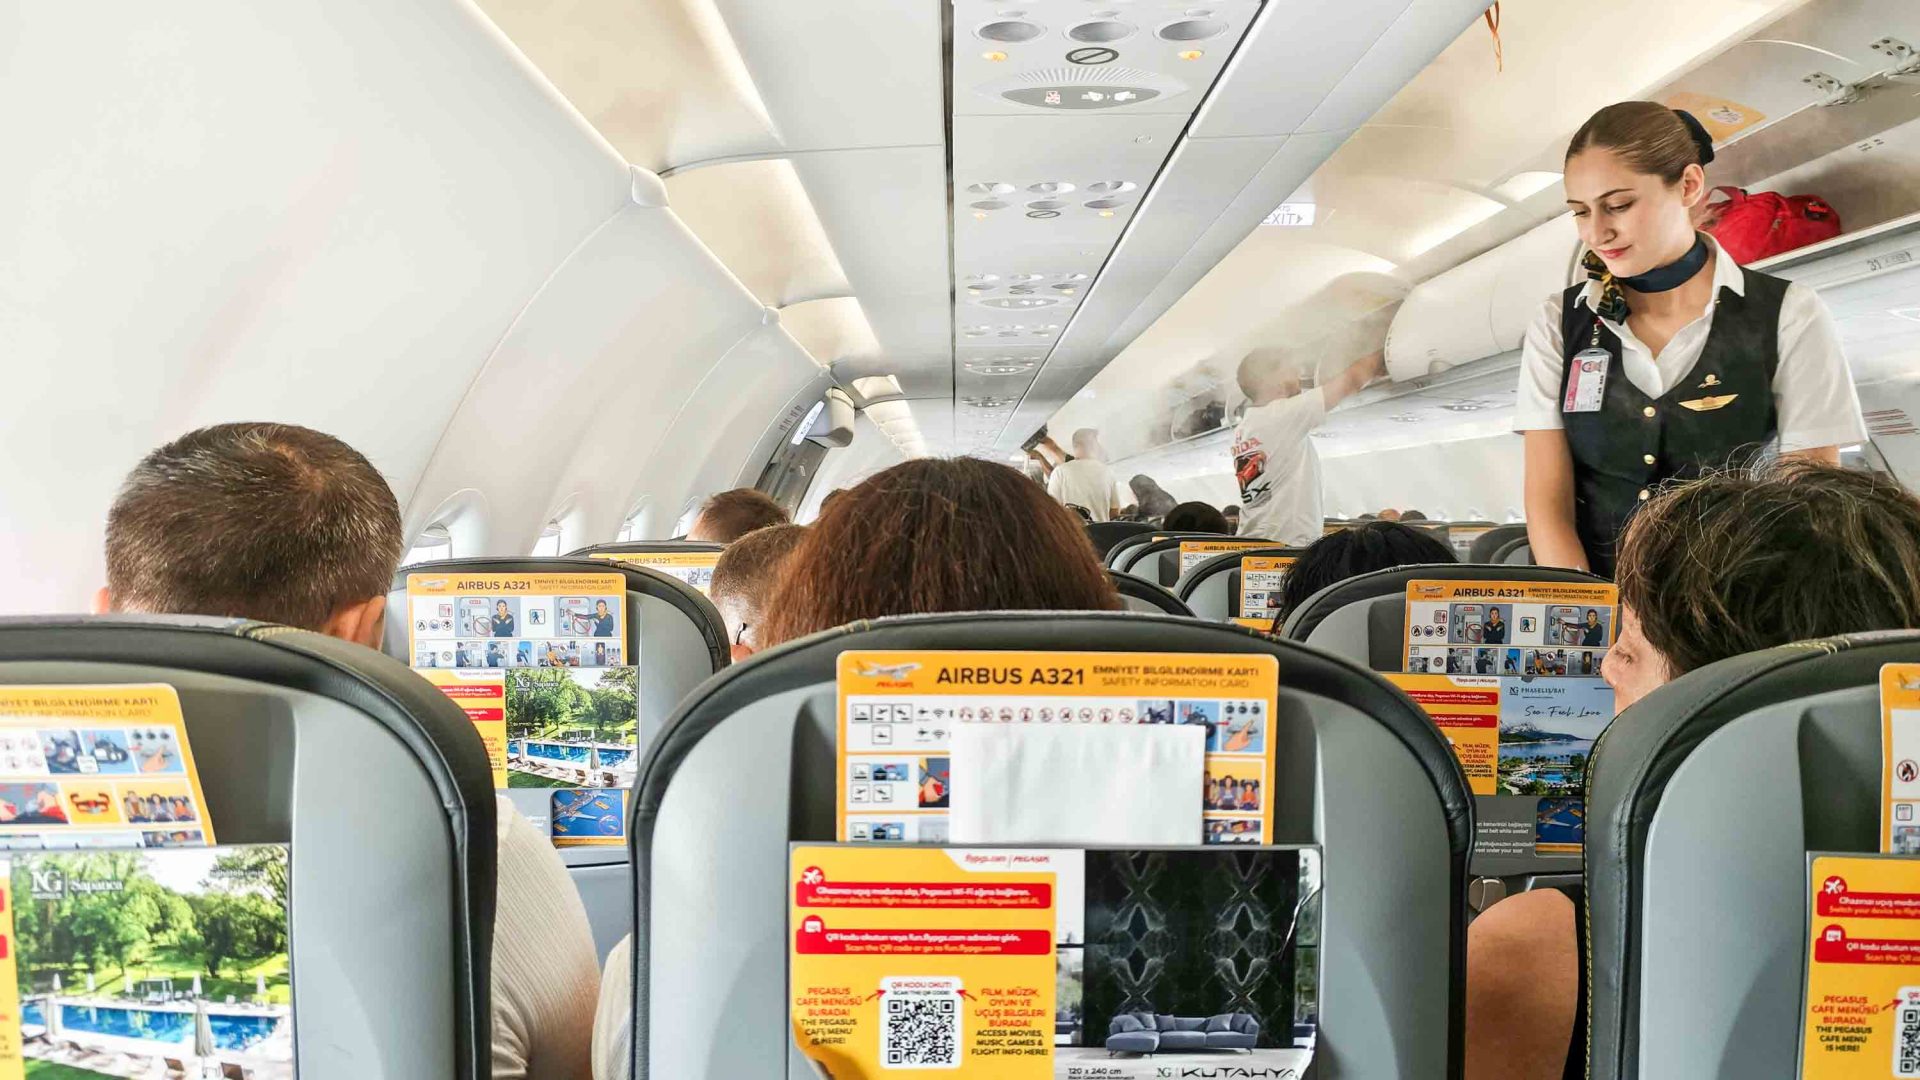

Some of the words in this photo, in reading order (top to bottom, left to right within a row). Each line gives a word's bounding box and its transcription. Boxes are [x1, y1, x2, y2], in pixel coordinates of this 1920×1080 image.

[1262, 213, 1297, 225] XIT
[652, 557, 671, 565] A321
[457, 580, 500, 591] AIRBUS
[503, 580, 531, 590] A321
[1453, 588, 1495, 598] AIRBUS
[1498, 588, 1525, 598] A321
[1092, 665, 1140, 675] EMNİYET
[1142, 666, 1225, 677] BİLGİLENDİRME
[1226, 668, 1259, 677] KARTI
[936, 667, 1023, 685] AIRBUS
[1029, 668, 1084, 685] A321
[516, 677, 530, 687] NG
[1101, 676, 1141, 687] SAFETY
[1143, 677, 1217, 688] INFORMATION
[1219, 679, 1249, 688] CARD
[1509, 686, 1519, 694] NG
[1577, 706, 1601, 718] Love
[32, 870, 62, 892] NG
[70, 879, 123, 893] Sapanca
[879, 944, 893, 953] QR
[1846, 942, 1860, 952] QR
[1865, 953, 1885, 961] Scan
[1885, 954, 1899, 962] the
[1899, 954, 1912, 963] QR
[807, 987, 851, 995] PEGASUS
[1907, 991, 1919, 999] QR
[796, 997, 819, 1006] CAFE
[821, 995, 863, 1006] MENÜSÜ
[989, 999, 1017, 1007] OYUN
[1020, 999, 1032, 1007] VE
[1823, 995, 1868, 1004] PEGASUS
[807, 1008, 851, 1017] BURADA!
[974, 1008, 1002, 1019] UÇUŞ
[1811, 1005, 1835, 1014] CAFE
[1837, 1004, 1879, 1015] MENÜSÜ
[800, 1018, 817, 1026] THE
[818, 1018, 858, 1026] PEGASUS
[989, 1019, 1032, 1028] BURADA!
[1823, 1015, 1867, 1025] BURADA!
[827, 1027, 853, 1036] MENU
[976, 1029, 1008, 1037] ACCESS
[1009, 1029, 1044, 1038] MOVIES,
[1816, 1025, 1832, 1033] THE
[1834, 1026, 1873, 1034] PEGASUS
[976, 1039, 1006, 1047] MUSIC,
[1006, 1039, 1036, 1047] GAMES
[1820, 1035, 1840, 1043] CAFE
[1842, 1036, 1868, 1044] MENU
[971, 1048, 1001, 1056] FLIGHT
[1002, 1048, 1023, 1056] INFO
[1024, 1048, 1049, 1056] HERE!
[1825, 1044, 1834, 1052] IS
[1835, 1045, 1861, 1053] HERE!
[1068, 1067, 1083, 1075] 120
[1091, 1067, 1108, 1075] 240
[1156, 1067, 1172, 1078] NG
